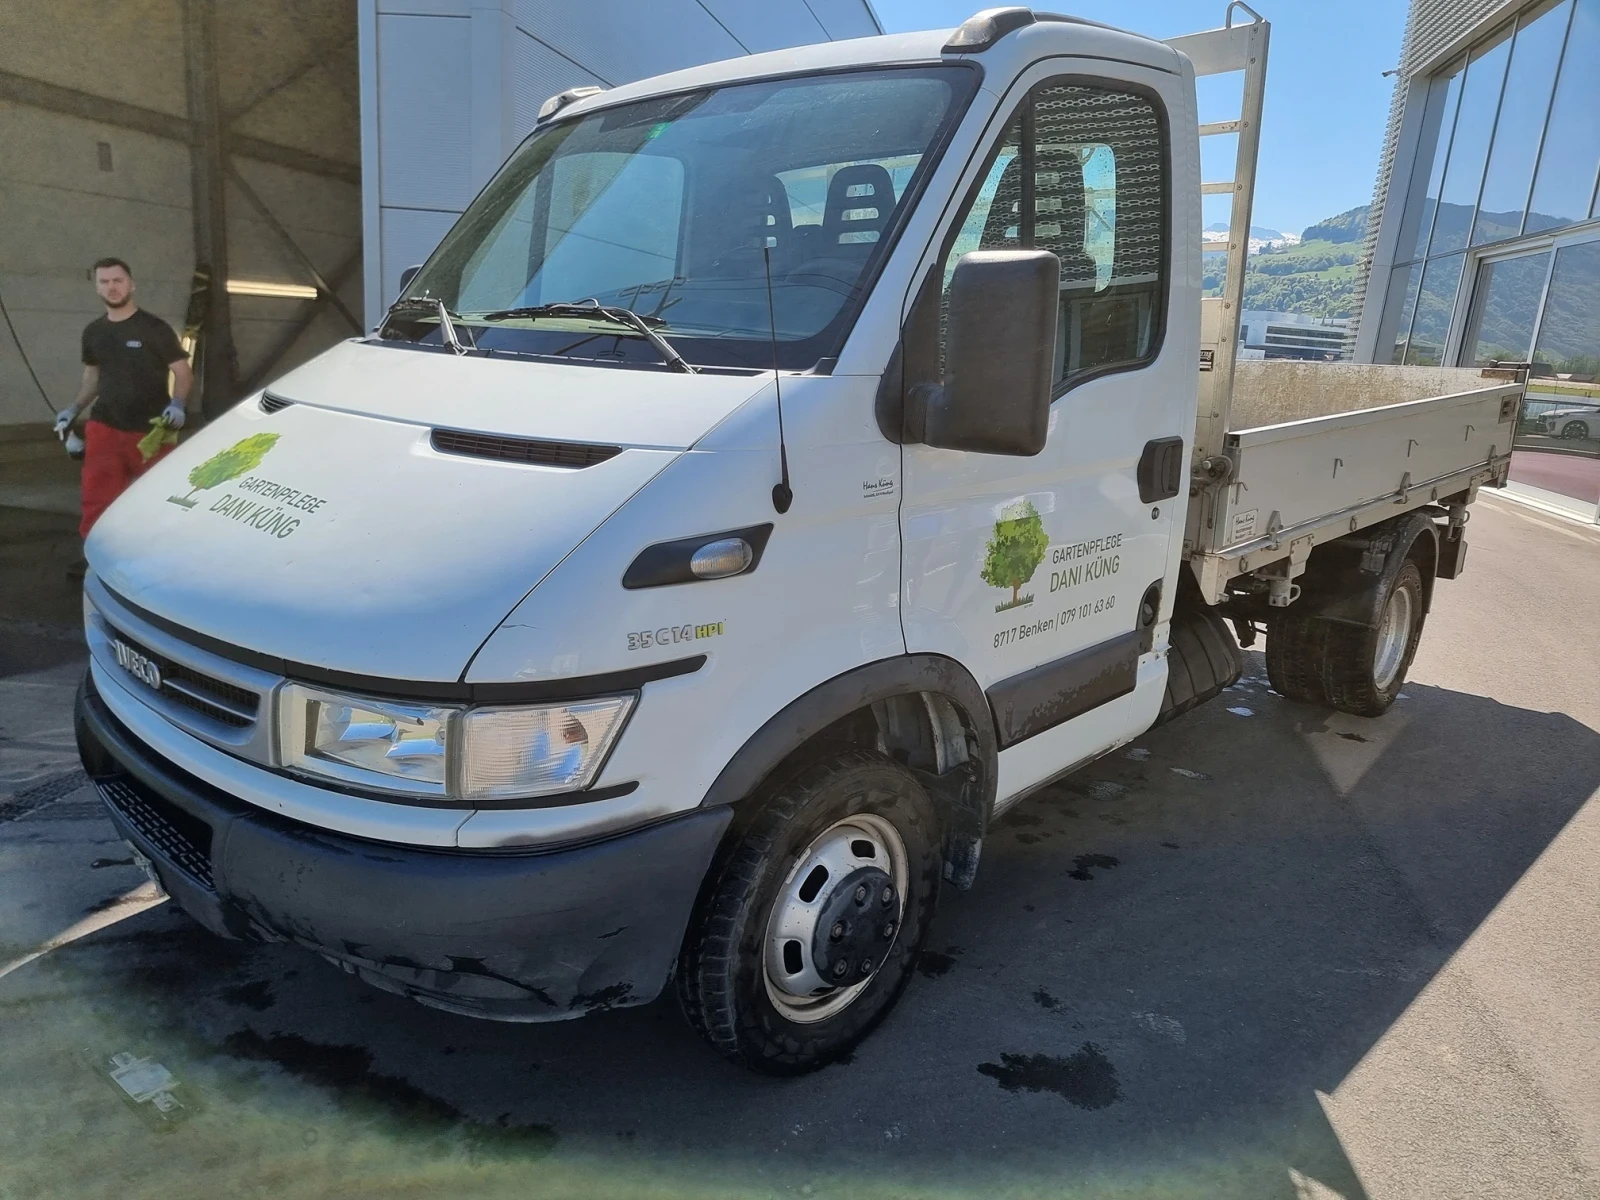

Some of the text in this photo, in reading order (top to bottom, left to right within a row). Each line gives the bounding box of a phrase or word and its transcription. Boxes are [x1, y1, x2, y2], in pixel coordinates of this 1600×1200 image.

[239, 476, 327, 514] GARTENPFLEGE
[209, 494, 301, 539] DANI KÜNG
[1052, 533, 1123, 565] GARTENPFLEGE
[1050, 555, 1120, 593] DANI KÜNG
[695, 622, 724, 639] HPI
[993, 628, 1017, 649] 8717
[1019, 620, 1054, 640] Benken
[1060, 608, 1077, 626] 079
[1078, 603, 1092, 619] 101
[1094, 599, 1104, 614] 63
[1105, 595, 1116, 610] 60
[115, 639, 160, 690] IVECO
